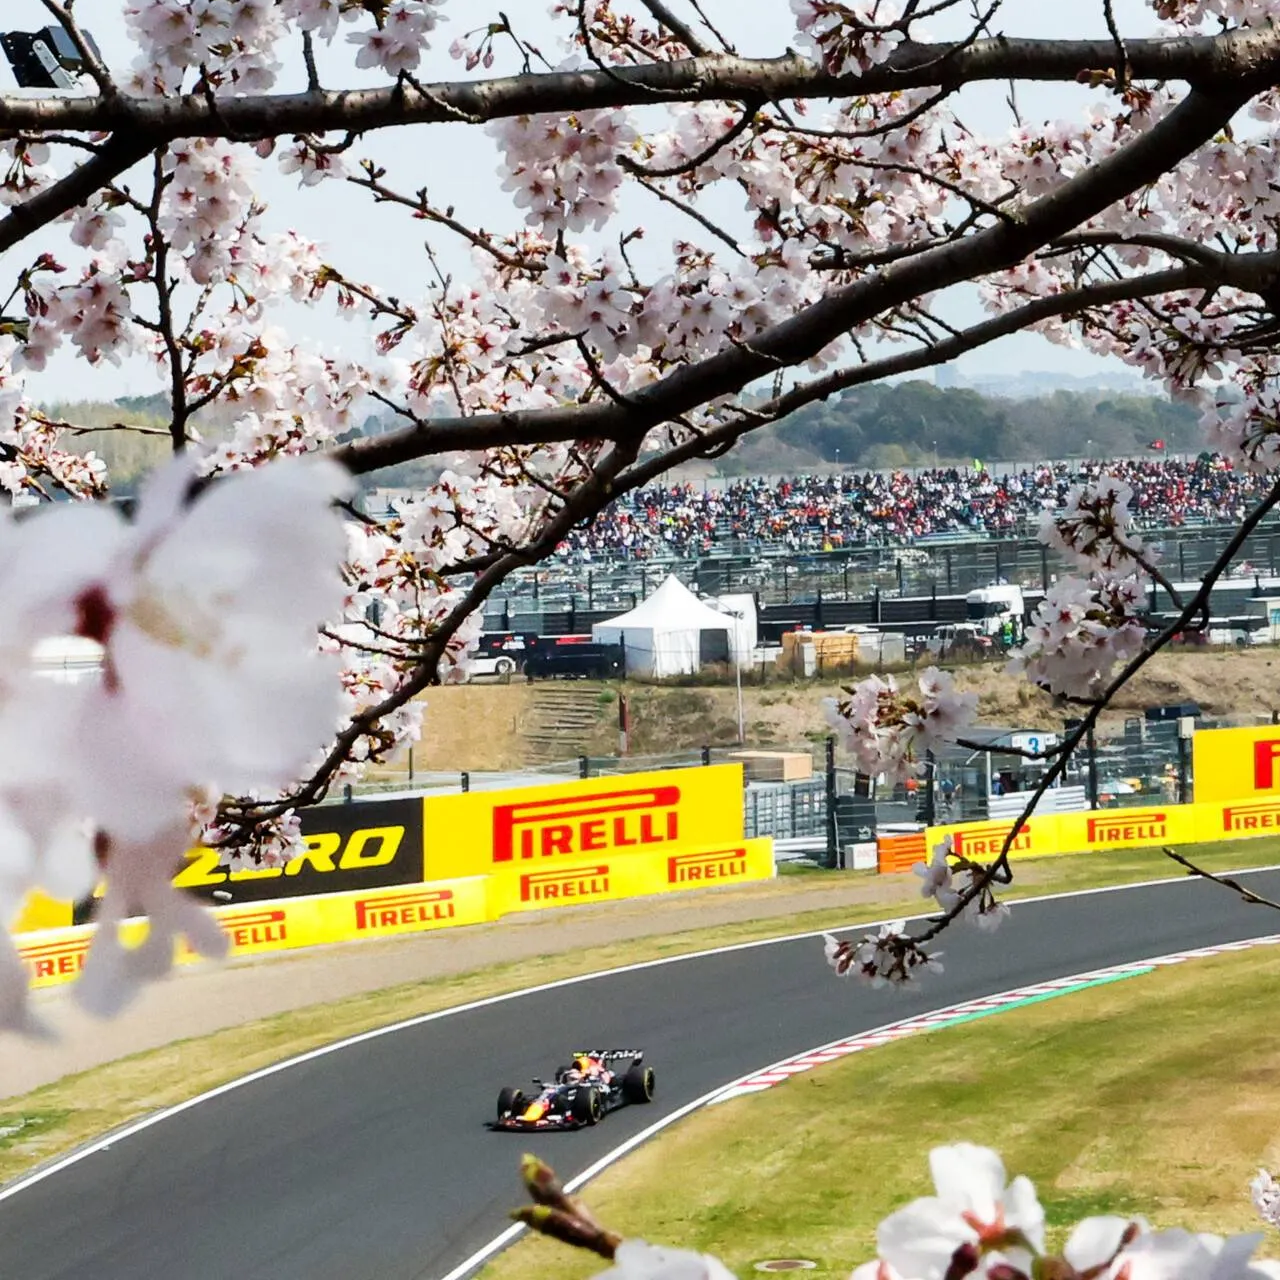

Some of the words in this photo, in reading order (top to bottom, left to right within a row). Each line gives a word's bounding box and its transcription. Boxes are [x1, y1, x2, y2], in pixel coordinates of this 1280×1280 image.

[493, 786, 680, 863] PIRELLI
[1087, 814, 1166, 843] PIRELLI
[172, 826, 405, 889] ZRO
[668, 848, 746, 883] PIRELLI
[520, 865, 609, 902] PIRELLI
[355, 890, 455, 929] PIRELLI
